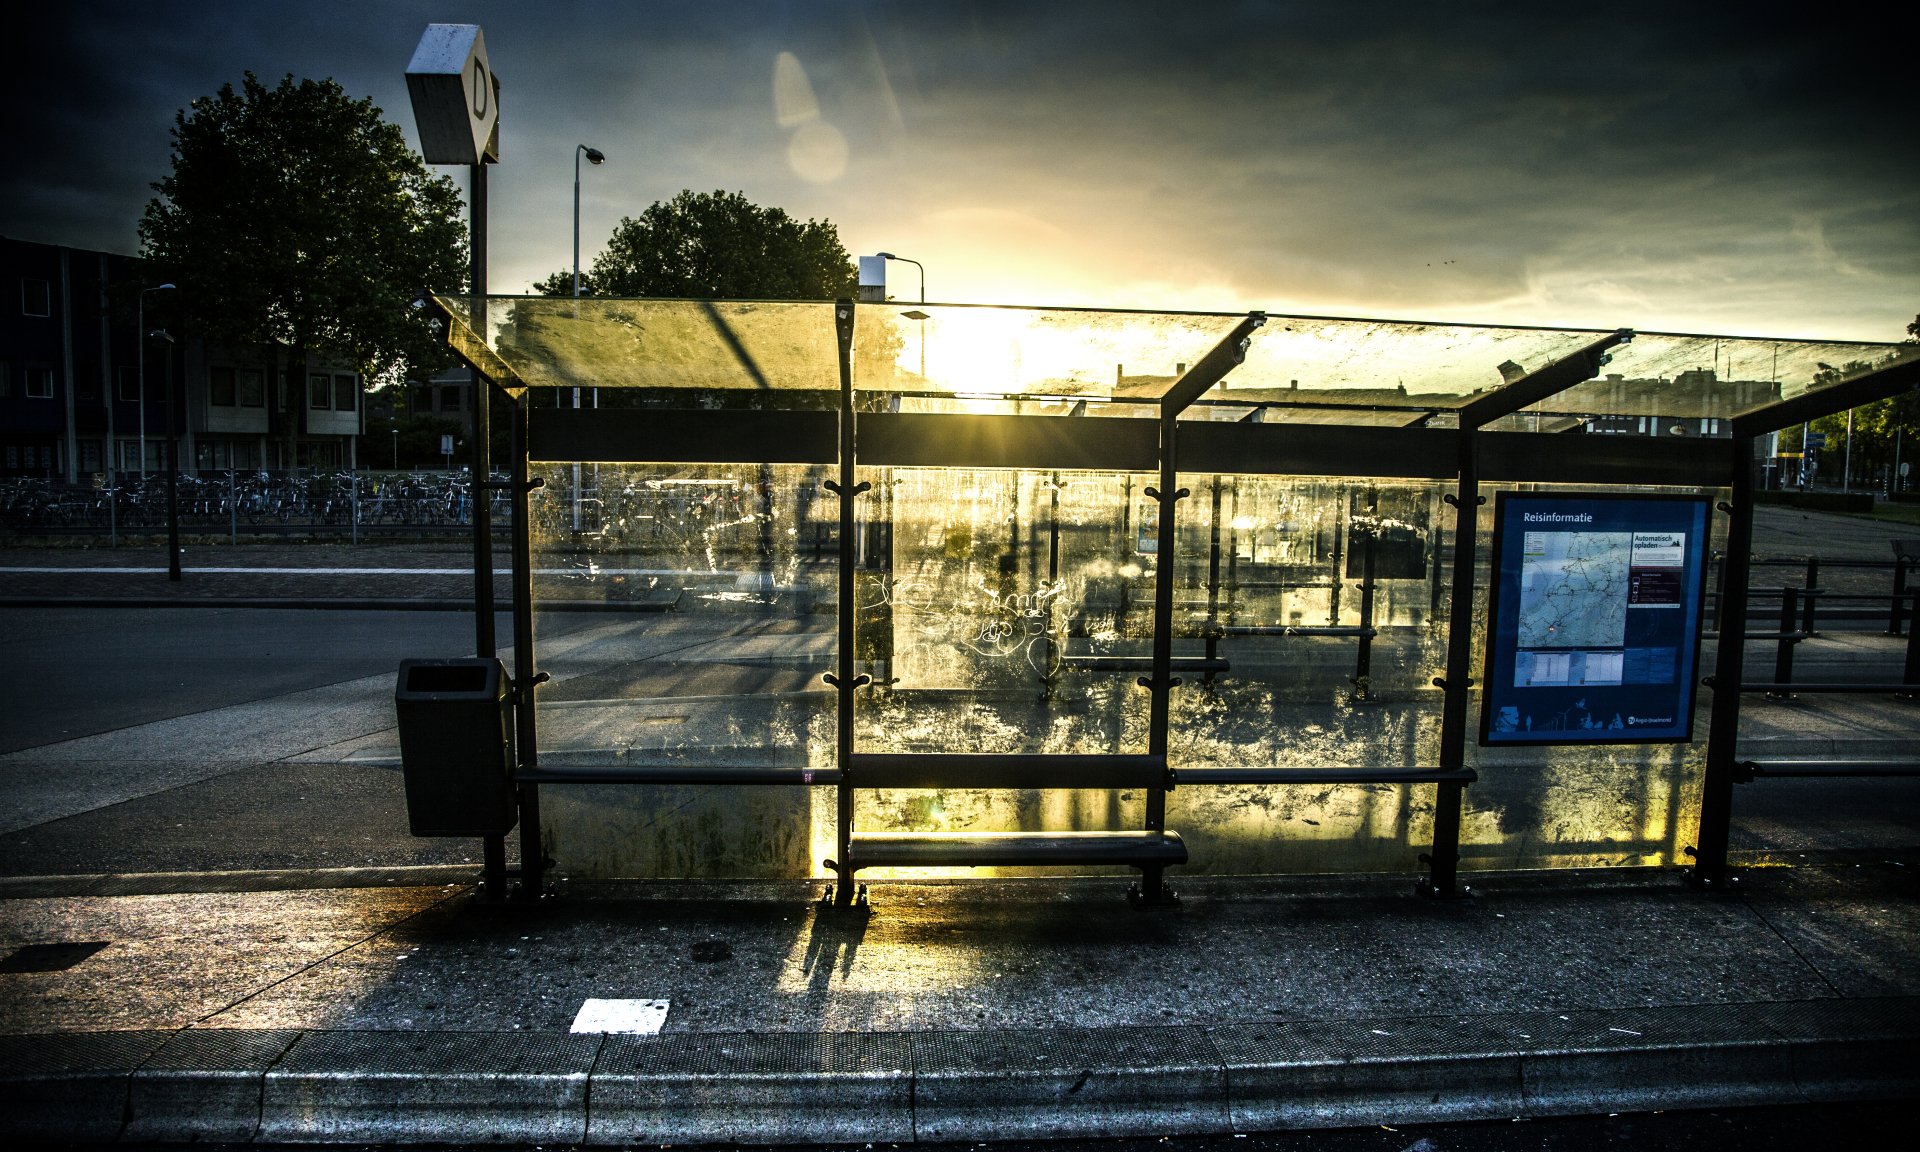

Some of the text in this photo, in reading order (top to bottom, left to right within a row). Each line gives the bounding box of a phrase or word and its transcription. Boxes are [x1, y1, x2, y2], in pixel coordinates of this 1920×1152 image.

[474, 56, 487, 121] D
[1524, 512, 1593, 523] Reisinformatie
[1635, 542, 1658, 550] opladen
